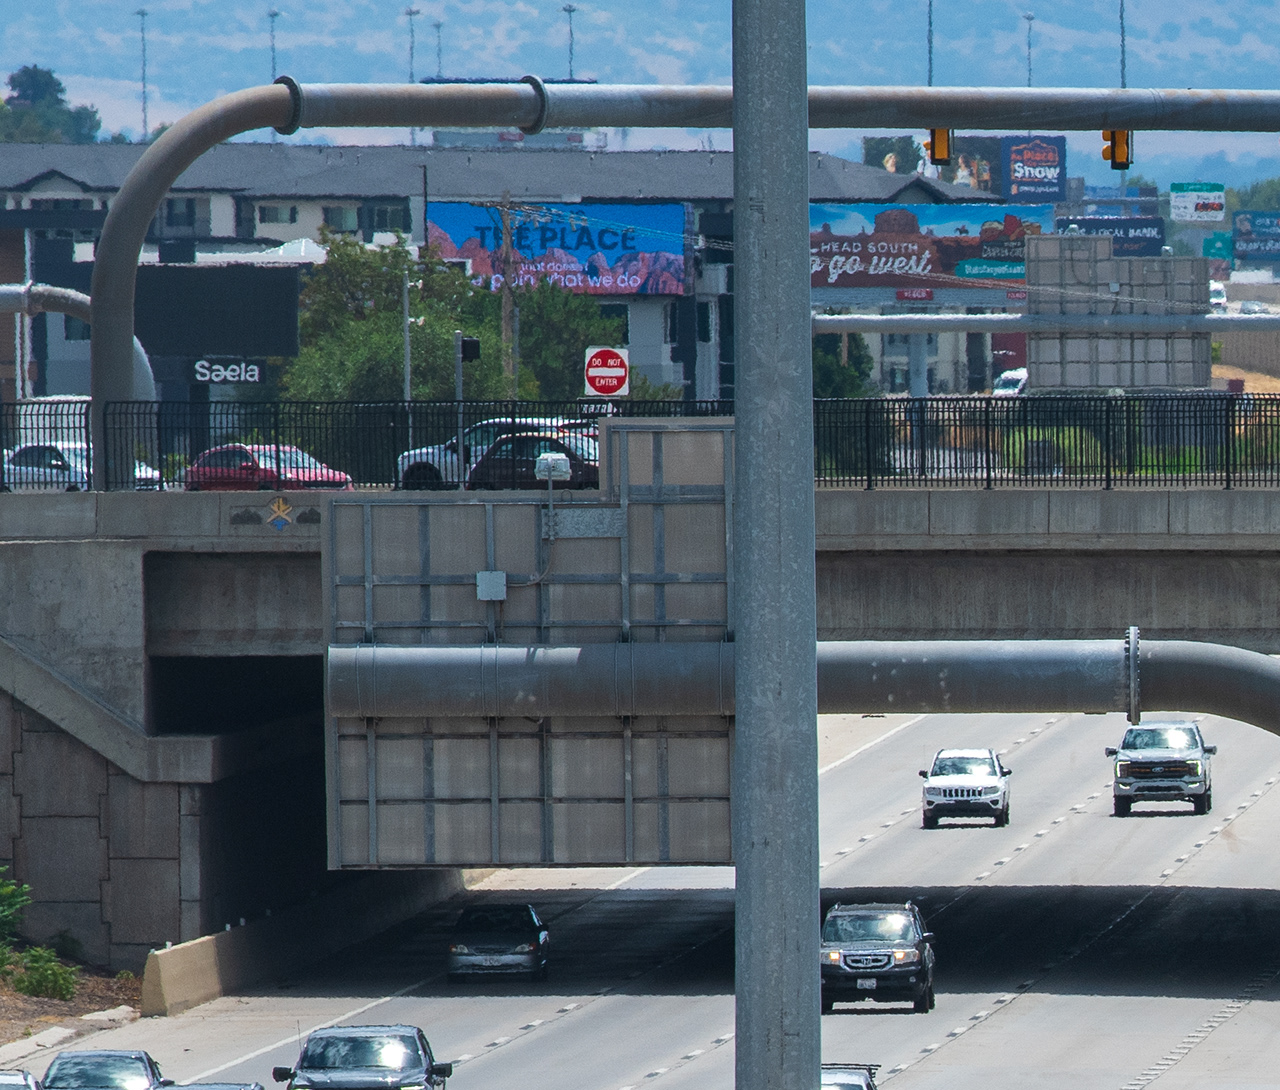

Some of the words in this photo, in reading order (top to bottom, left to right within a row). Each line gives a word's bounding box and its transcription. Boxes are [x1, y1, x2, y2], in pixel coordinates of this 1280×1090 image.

[1014, 162, 1061, 178] Snow
[540, 225, 637, 250] PLACE
[821, 241, 862, 253] HEAD
[867, 241, 918, 254] SOUTH
[827, 254, 864, 283] go
[868, 250, 932, 275] west
[588, 274, 613, 288] we
[617, 271, 641, 288] do
[592, 358, 602, 367] DO
[607, 358, 622, 367] NOT
[194, 360, 260, 382] Saela
[595, 377, 618, 387] ENTER
